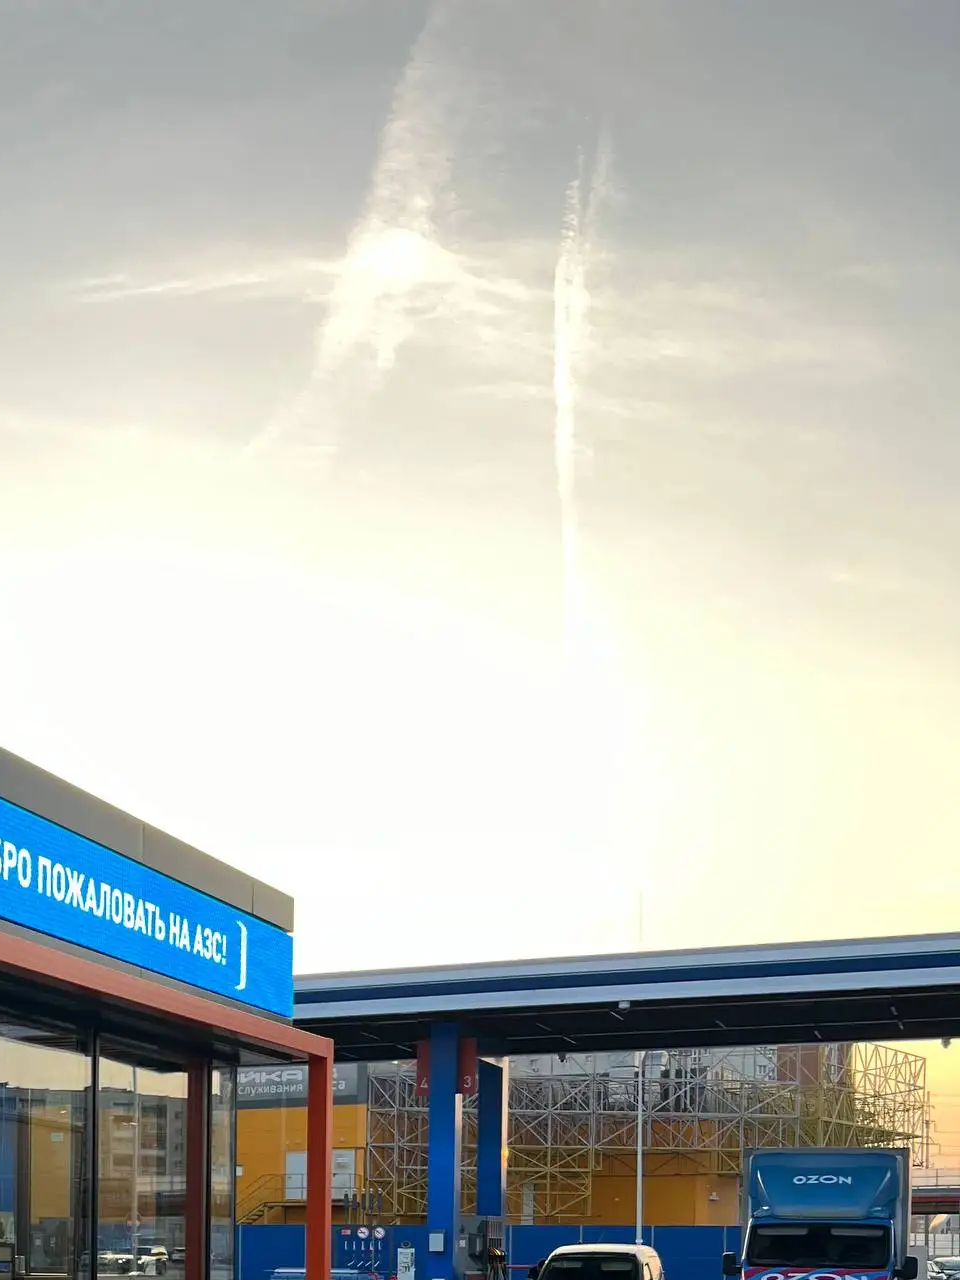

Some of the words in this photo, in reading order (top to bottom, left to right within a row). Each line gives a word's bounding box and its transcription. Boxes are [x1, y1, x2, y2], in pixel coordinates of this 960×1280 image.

[37, 855, 166, 942] ПОЖАЛОВАТЬ
[169, 911, 191, 953] НА
[193, 924, 227, 966] АЗС!
[420, 1076, 429, 1088] 4
[463, 1075, 472, 1088] 3
[793, 1175, 852, 1185] OZON
